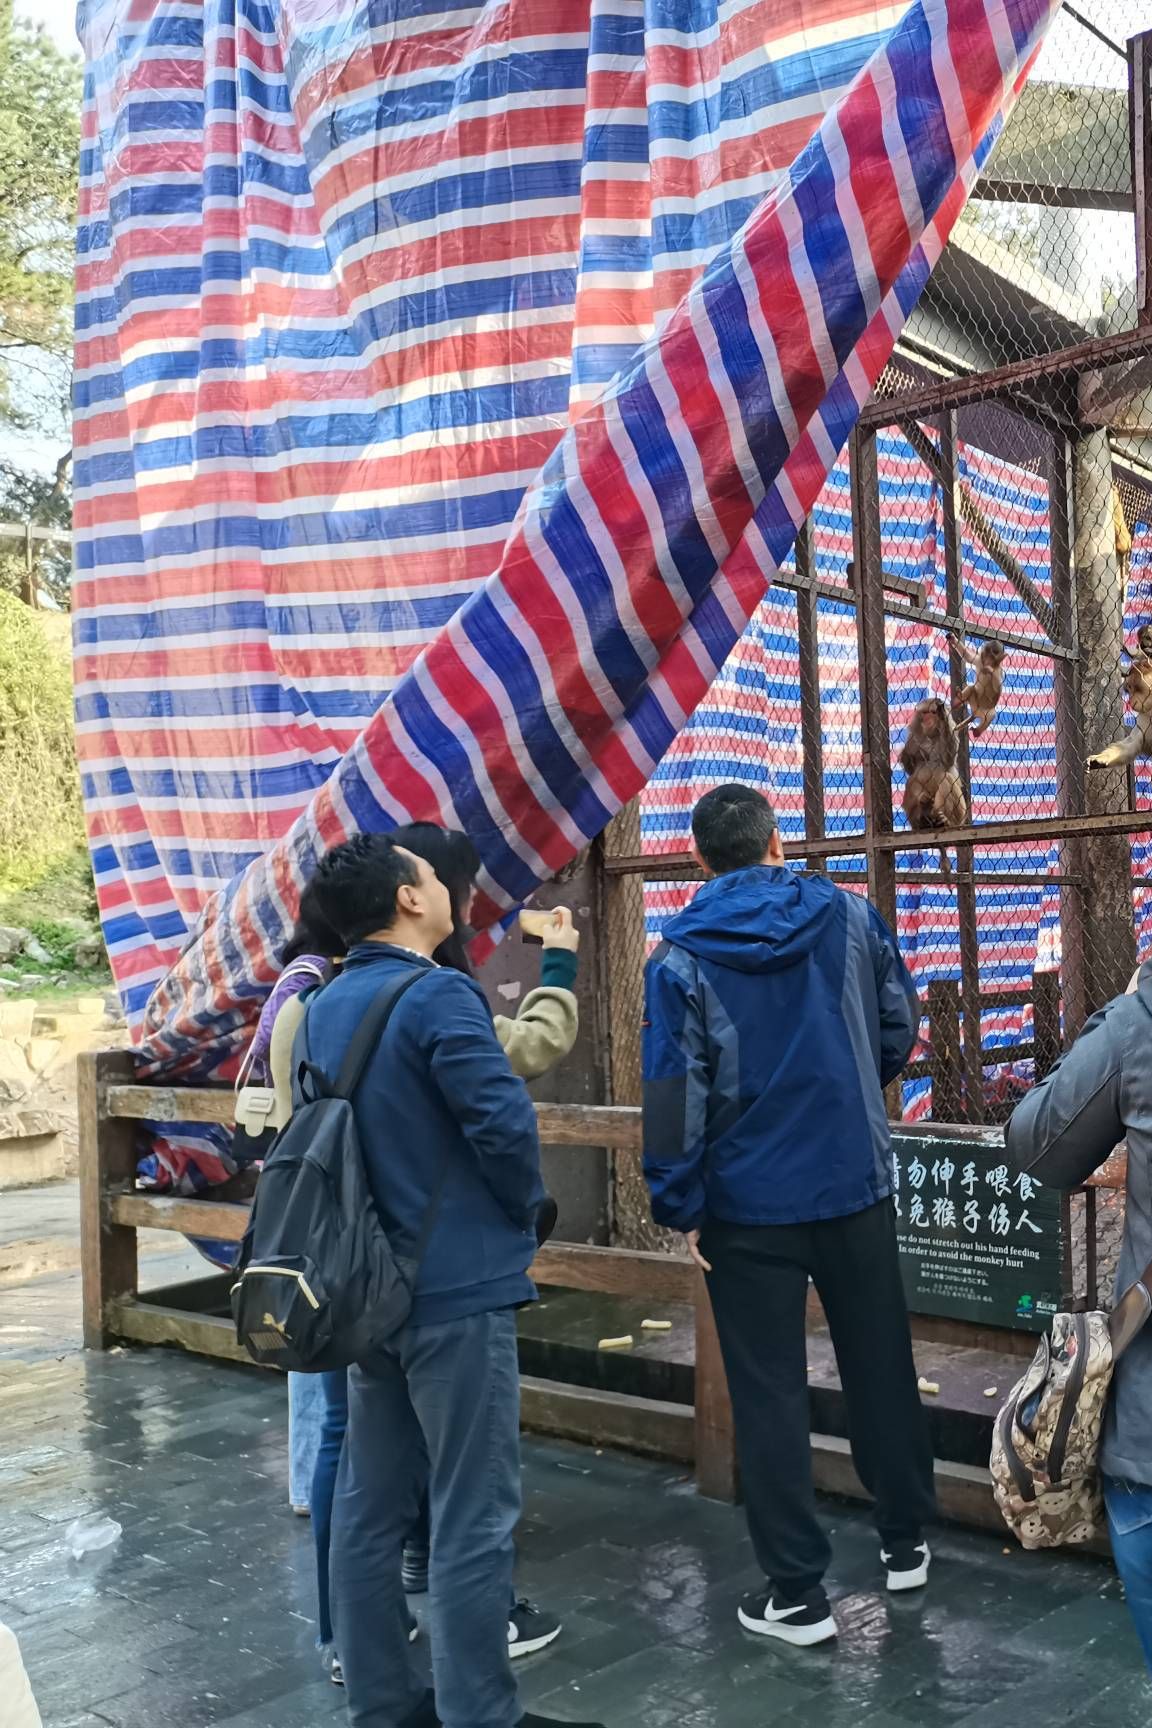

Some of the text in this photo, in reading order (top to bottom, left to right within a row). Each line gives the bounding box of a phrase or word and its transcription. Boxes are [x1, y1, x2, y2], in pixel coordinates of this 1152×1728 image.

[907, 1246, 928, 1256] order
[929, 1249, 937, 1257] to
[938, 1250, 959, 1260] avoid
[959, 1252, 973, 1261] the
[974, 1255, 1005, 1268] monkey
[1006, 1257, 1024, 1268] hurt
[908, 1233, 918, 1243] do
[918, 1237, 930, 1245] not
[932, 1238, 960, 1249] stretch
[960, 1242, 973, 1250] out
[975, 1241, 987, 1251] his
[988, 1243, 1009, 1254] hand
[1010, 1246, 1040, 1260] feeding
